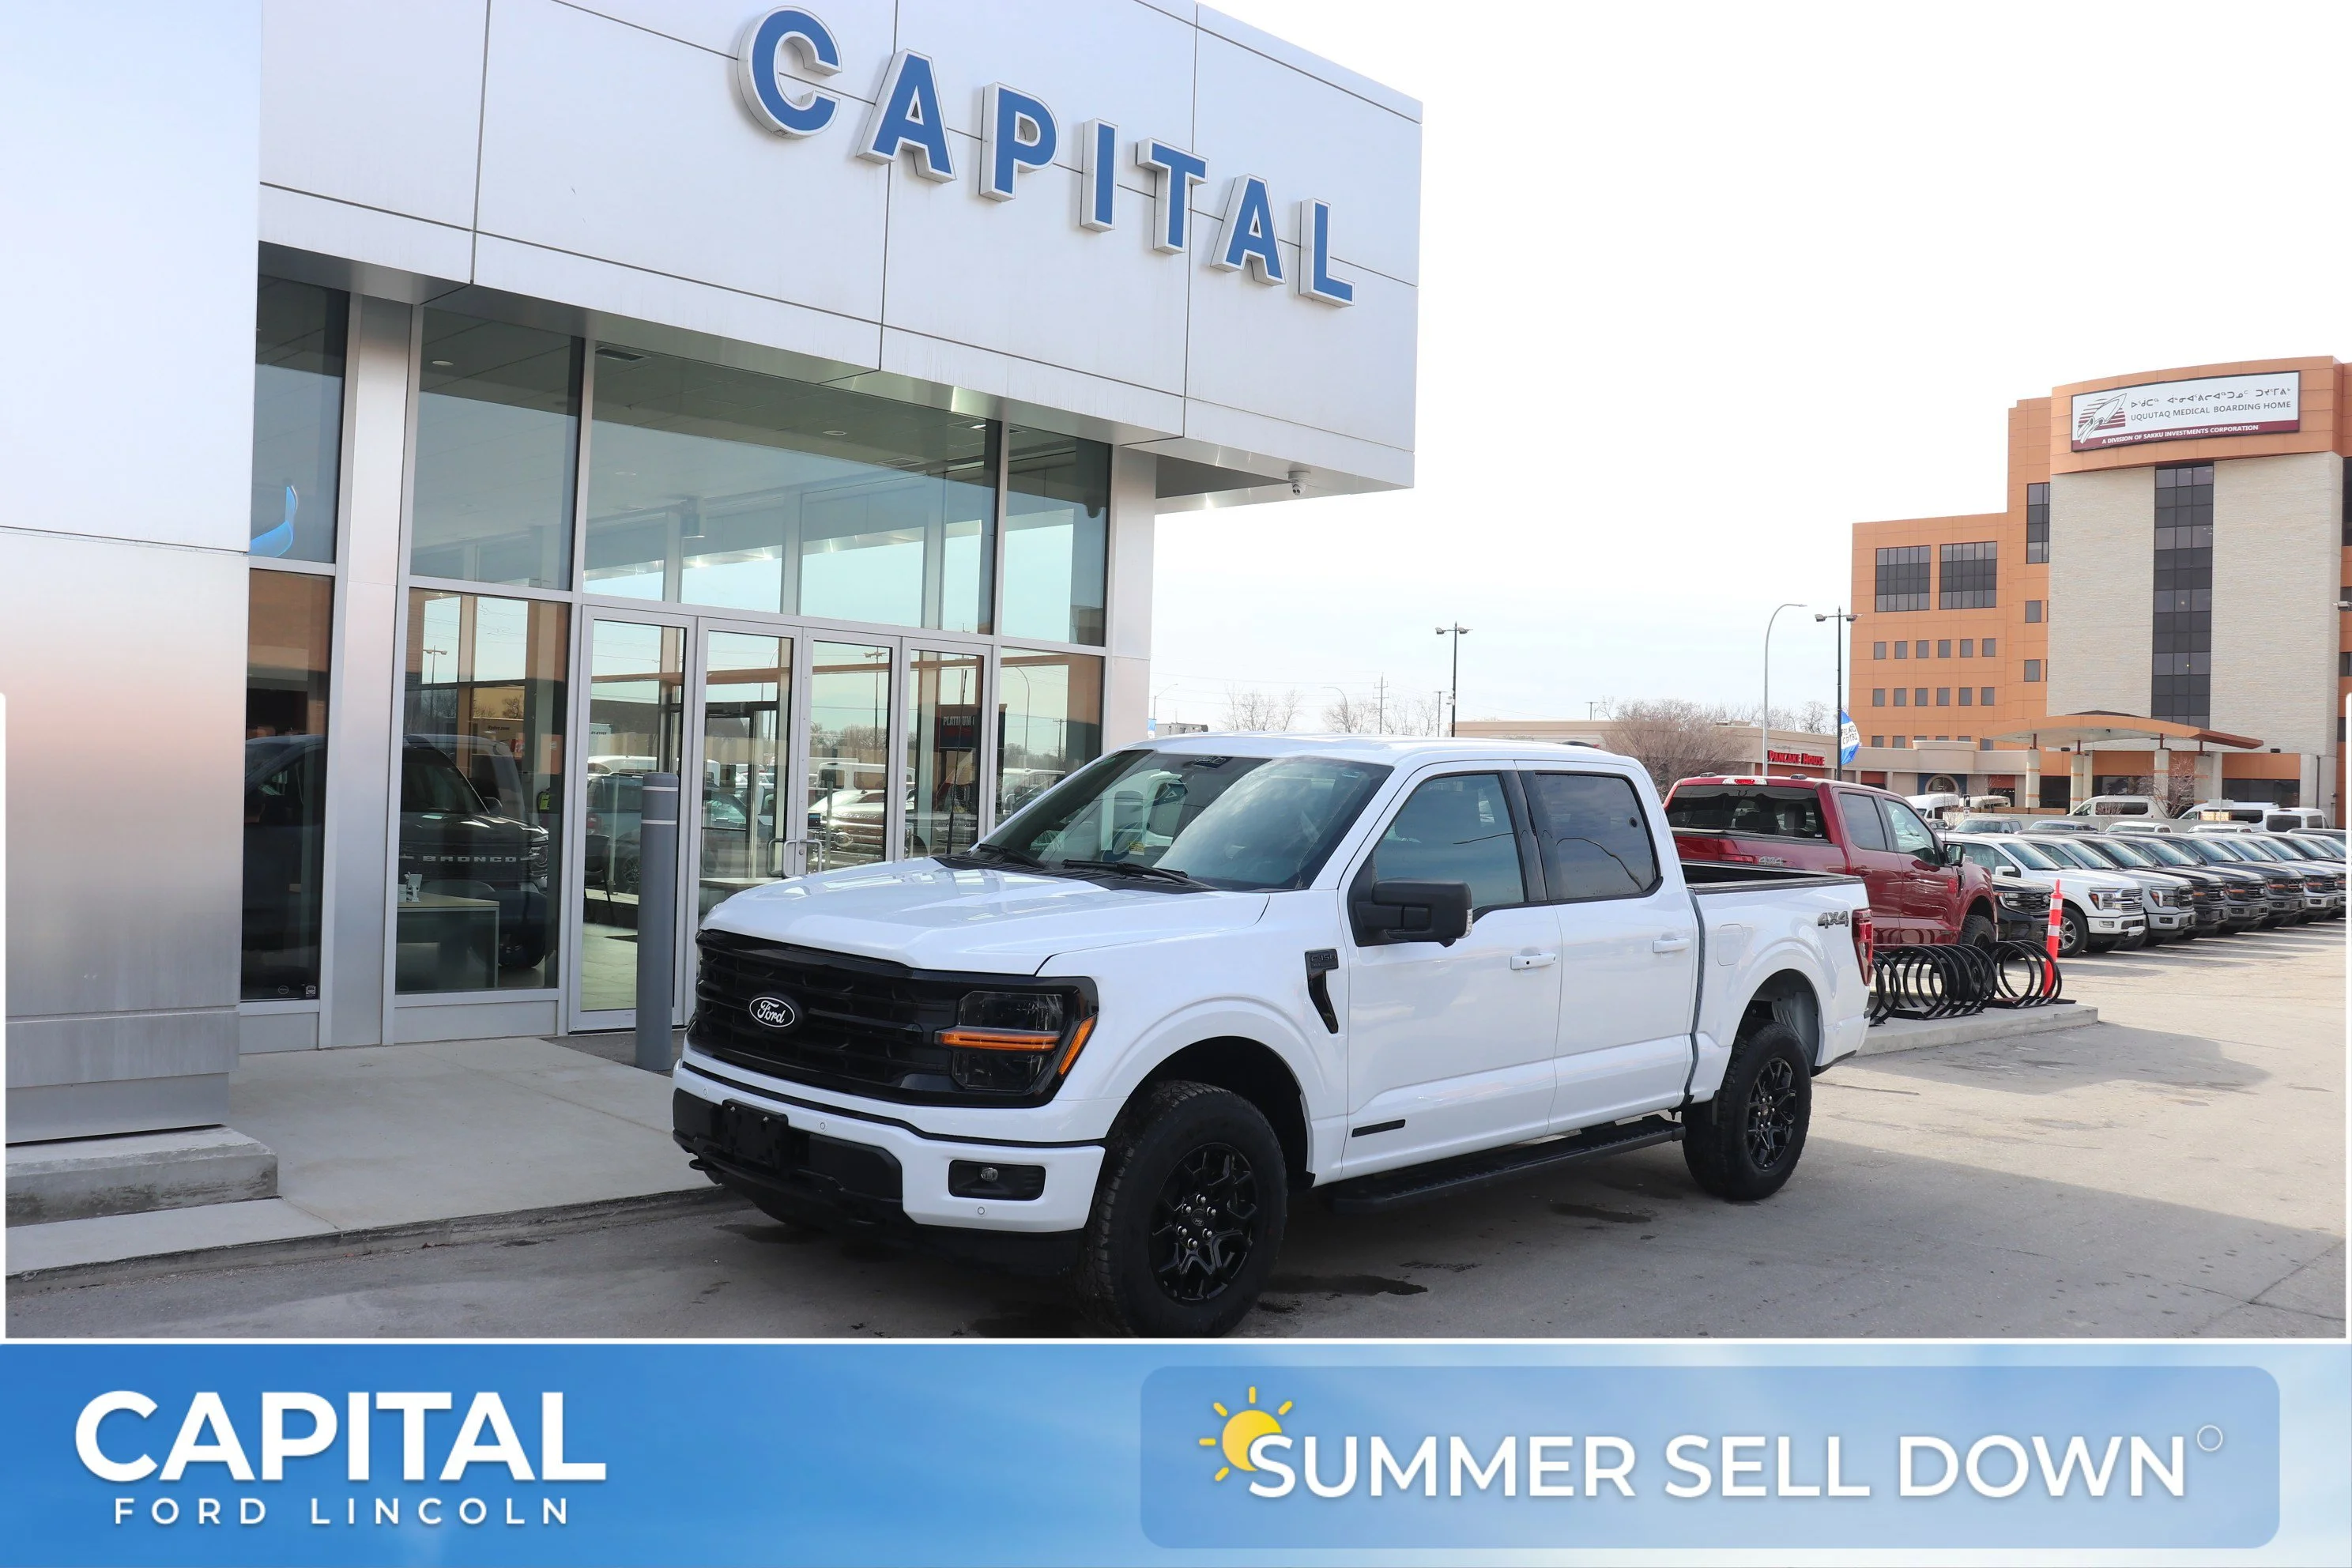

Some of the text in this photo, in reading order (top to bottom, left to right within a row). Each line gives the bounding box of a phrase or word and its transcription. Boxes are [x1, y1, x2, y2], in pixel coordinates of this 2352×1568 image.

[738, 6, 1355, 307] CAPITAL
[2131, 401, 2291, 421] UQUUTAQ MEDICAL BOARDING HOME
[2107, 435, 2133, 443] DIVISION
[2165, 428, 2209, 436] INVESTMENTS
[1767, 750, 1826, 767] PANCAKE HOUSE
[757, 1000, 786, 1023] Ford
